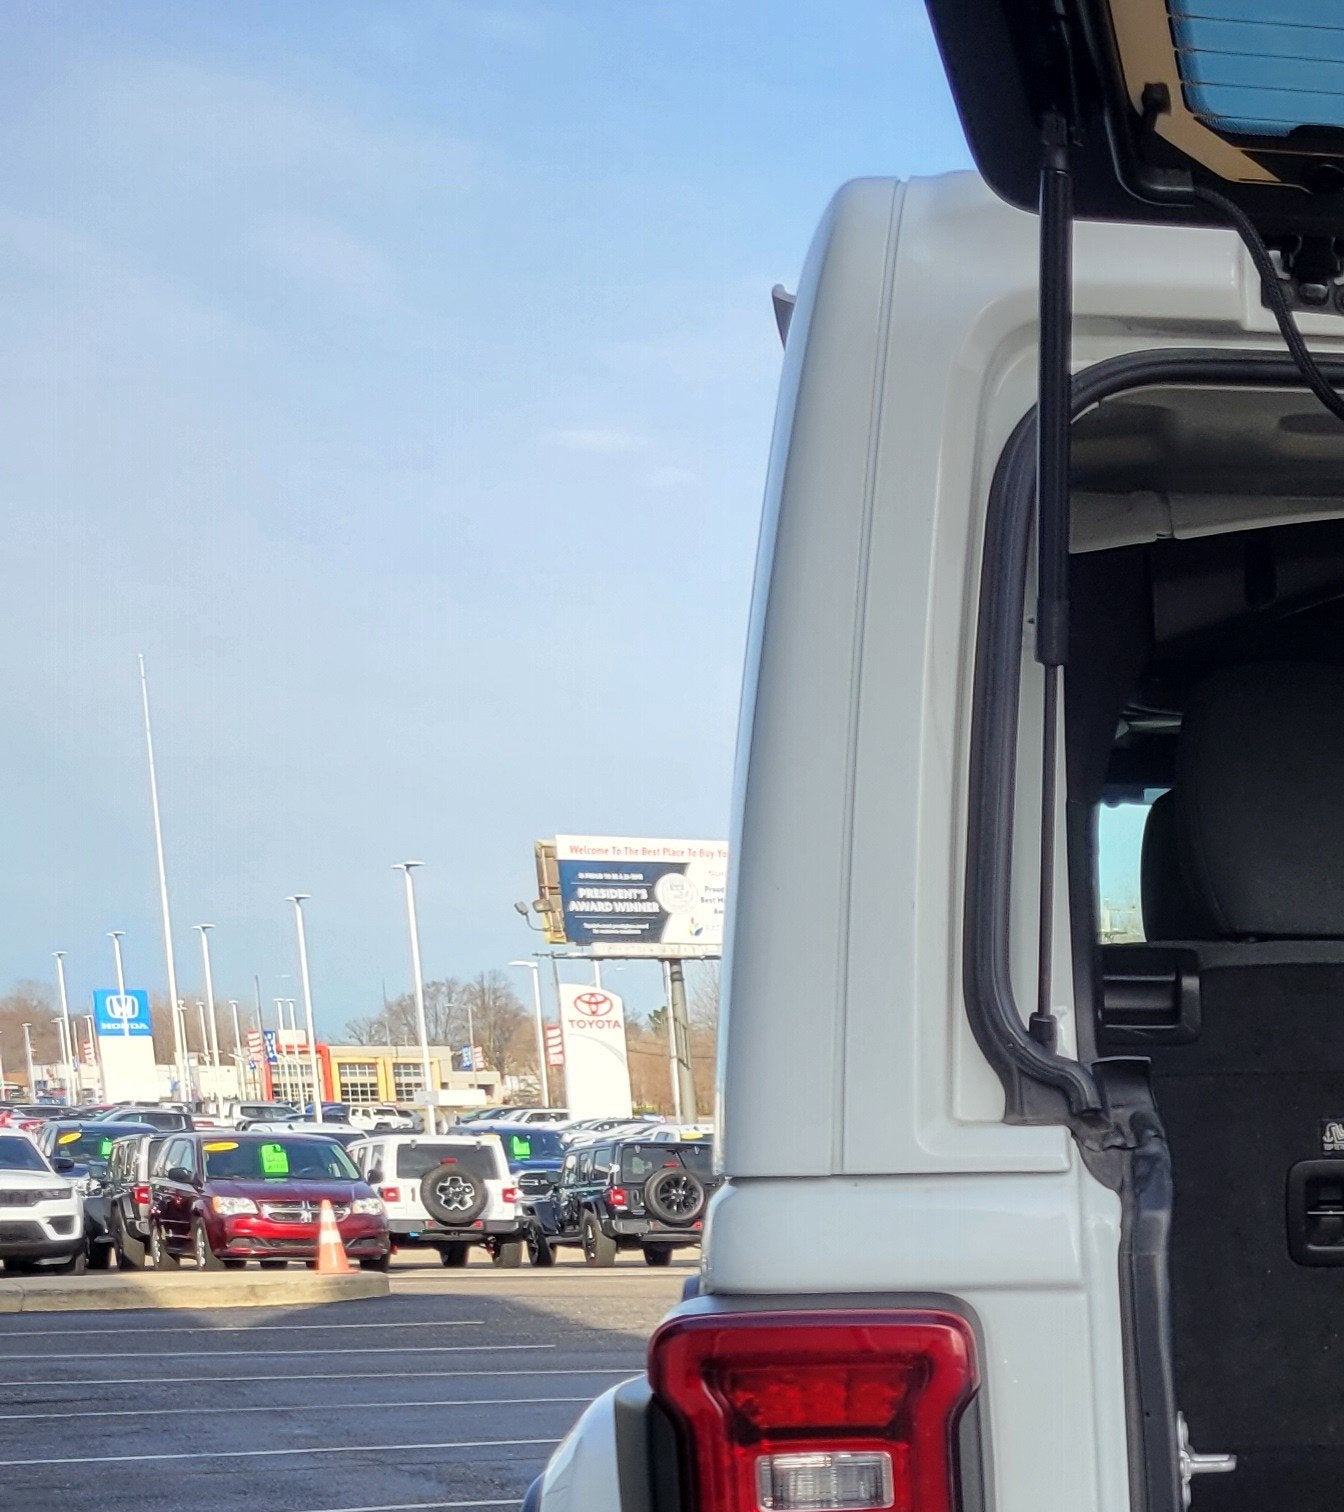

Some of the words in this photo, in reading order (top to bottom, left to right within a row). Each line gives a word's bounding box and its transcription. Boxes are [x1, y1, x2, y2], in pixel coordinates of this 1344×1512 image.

[569, 844, 609, 856] Welcome
[612, 846, 621, 856] To
[624, 846, 639, 856] The
[641, 847, 661, 857] Best
[662, 847, 685, 858] Place
[687, 848, 697, 858] To
[699, 848, 714, 860] Buy
[717, 849, 727, 858] Yo
[577, 887, 649, 900] PRESIDENT'S
[568, 901, 613, 913] AWARD
[613, 902, 661, 913] WINNER
[568, 1019, 622, 1030] TOYOTA
